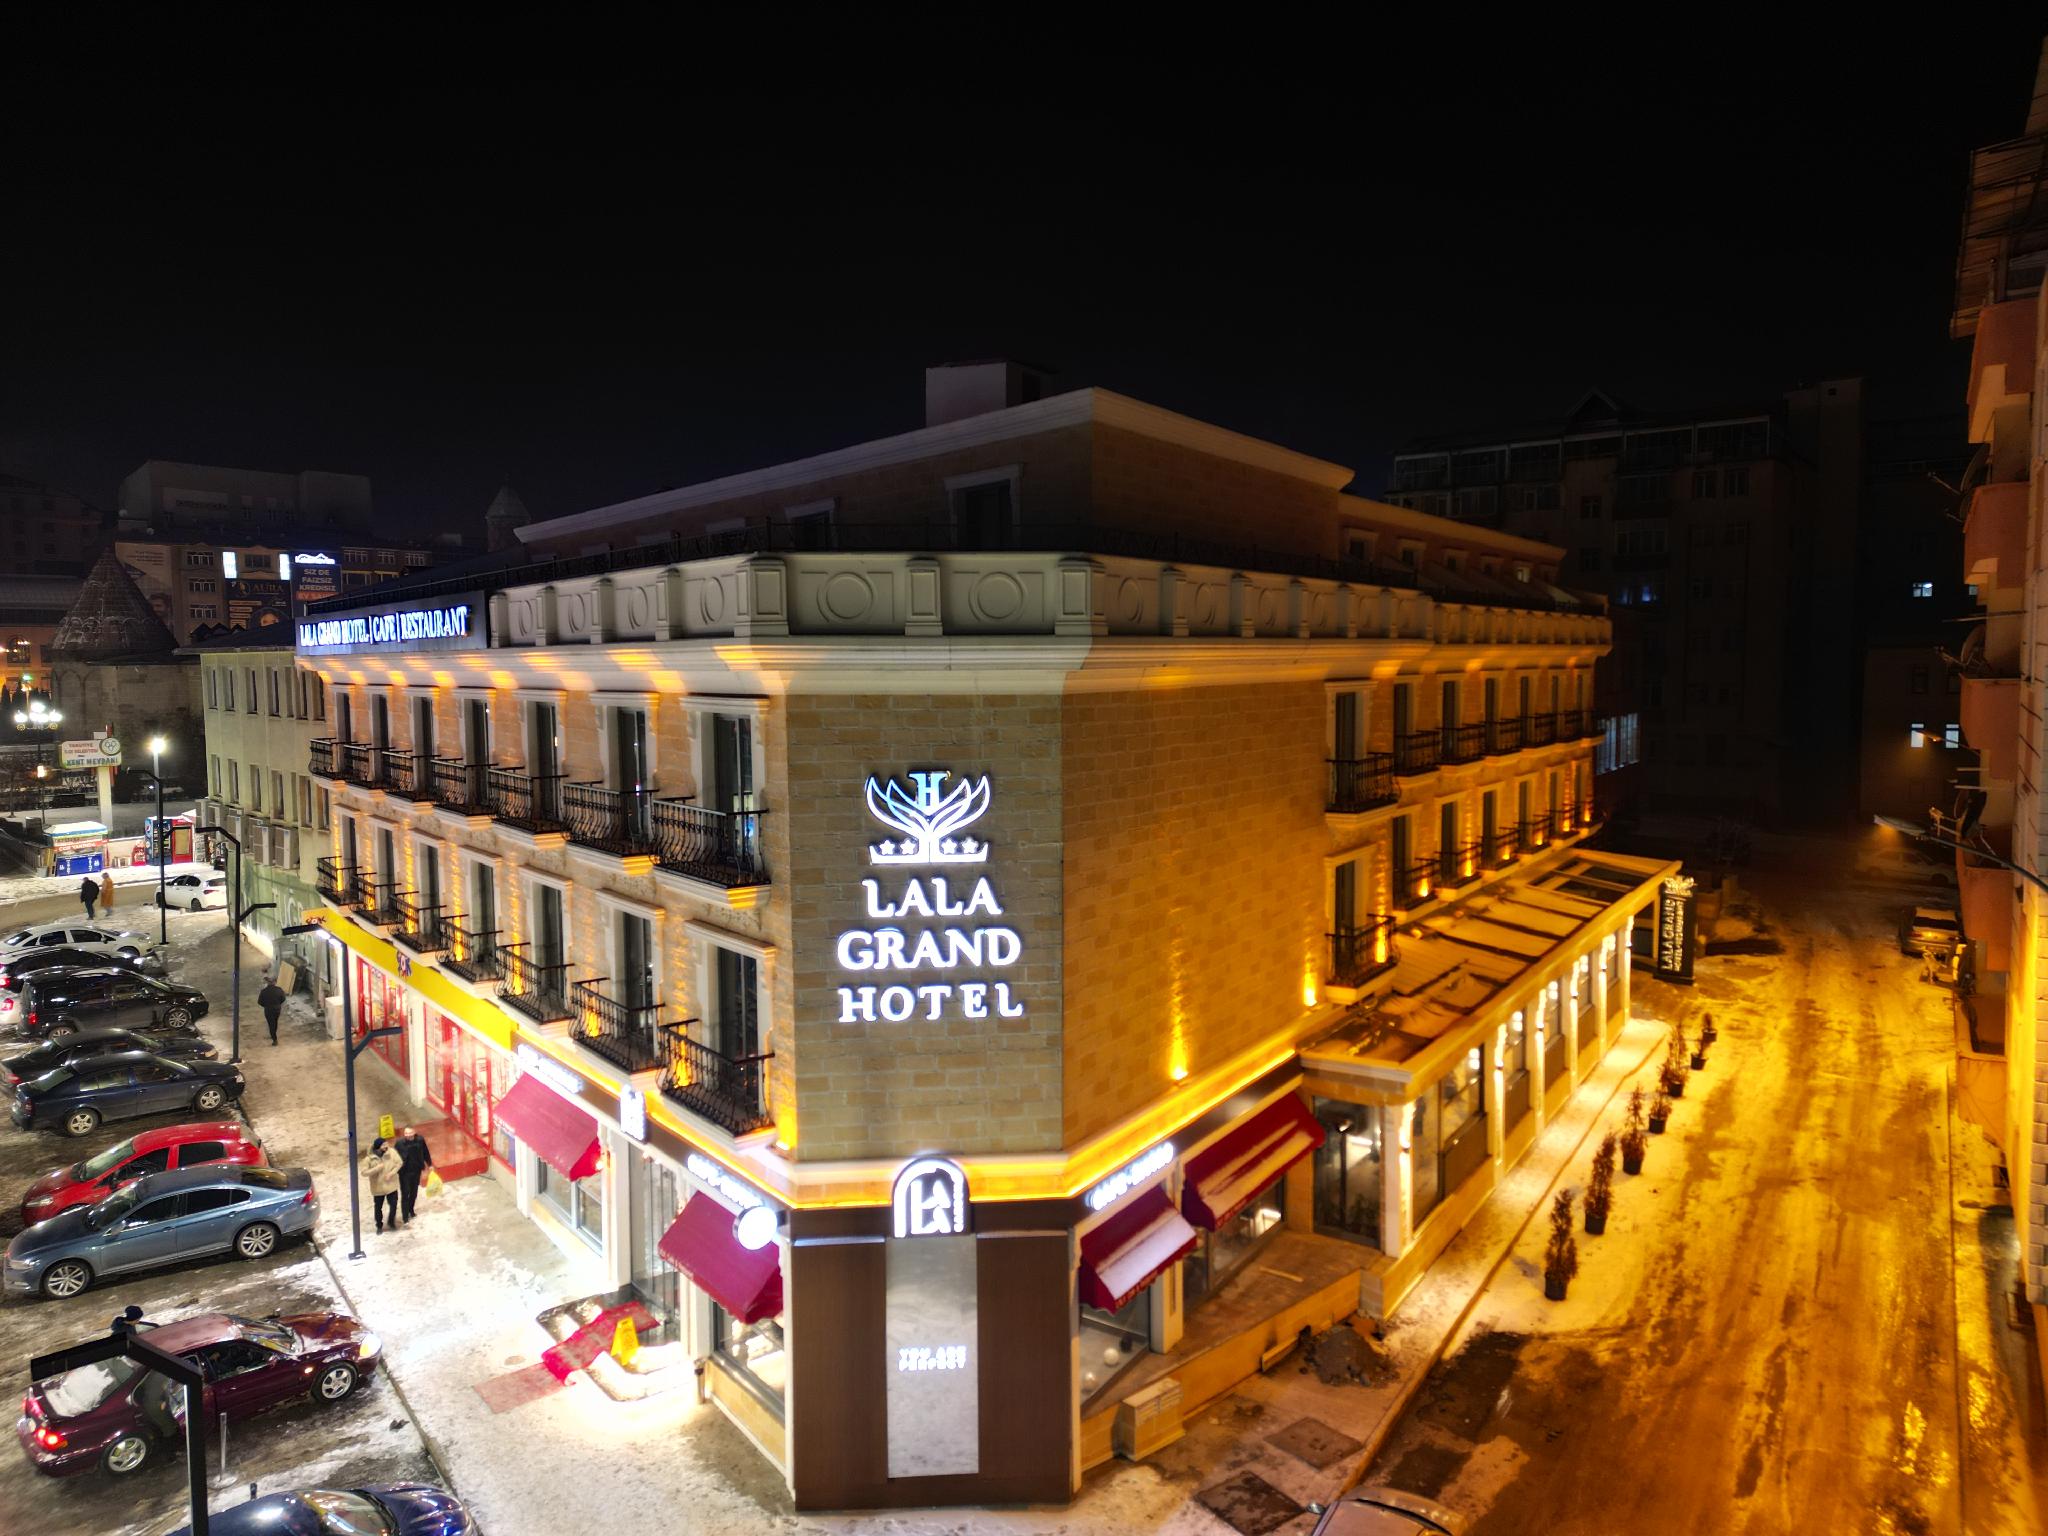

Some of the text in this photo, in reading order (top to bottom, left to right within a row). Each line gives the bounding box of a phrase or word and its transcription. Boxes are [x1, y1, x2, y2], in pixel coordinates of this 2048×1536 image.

[299, 605, 468, 647] LALA GRAND HOTEL CAFE RESTAURANT
[861, 876, 1004, 918] LALA
[836, 927, 1022, 970] GRAND
[1661, 899, 1675, 970] LALA GRAND
[837, 982, 1024, 1023] HOTEL
